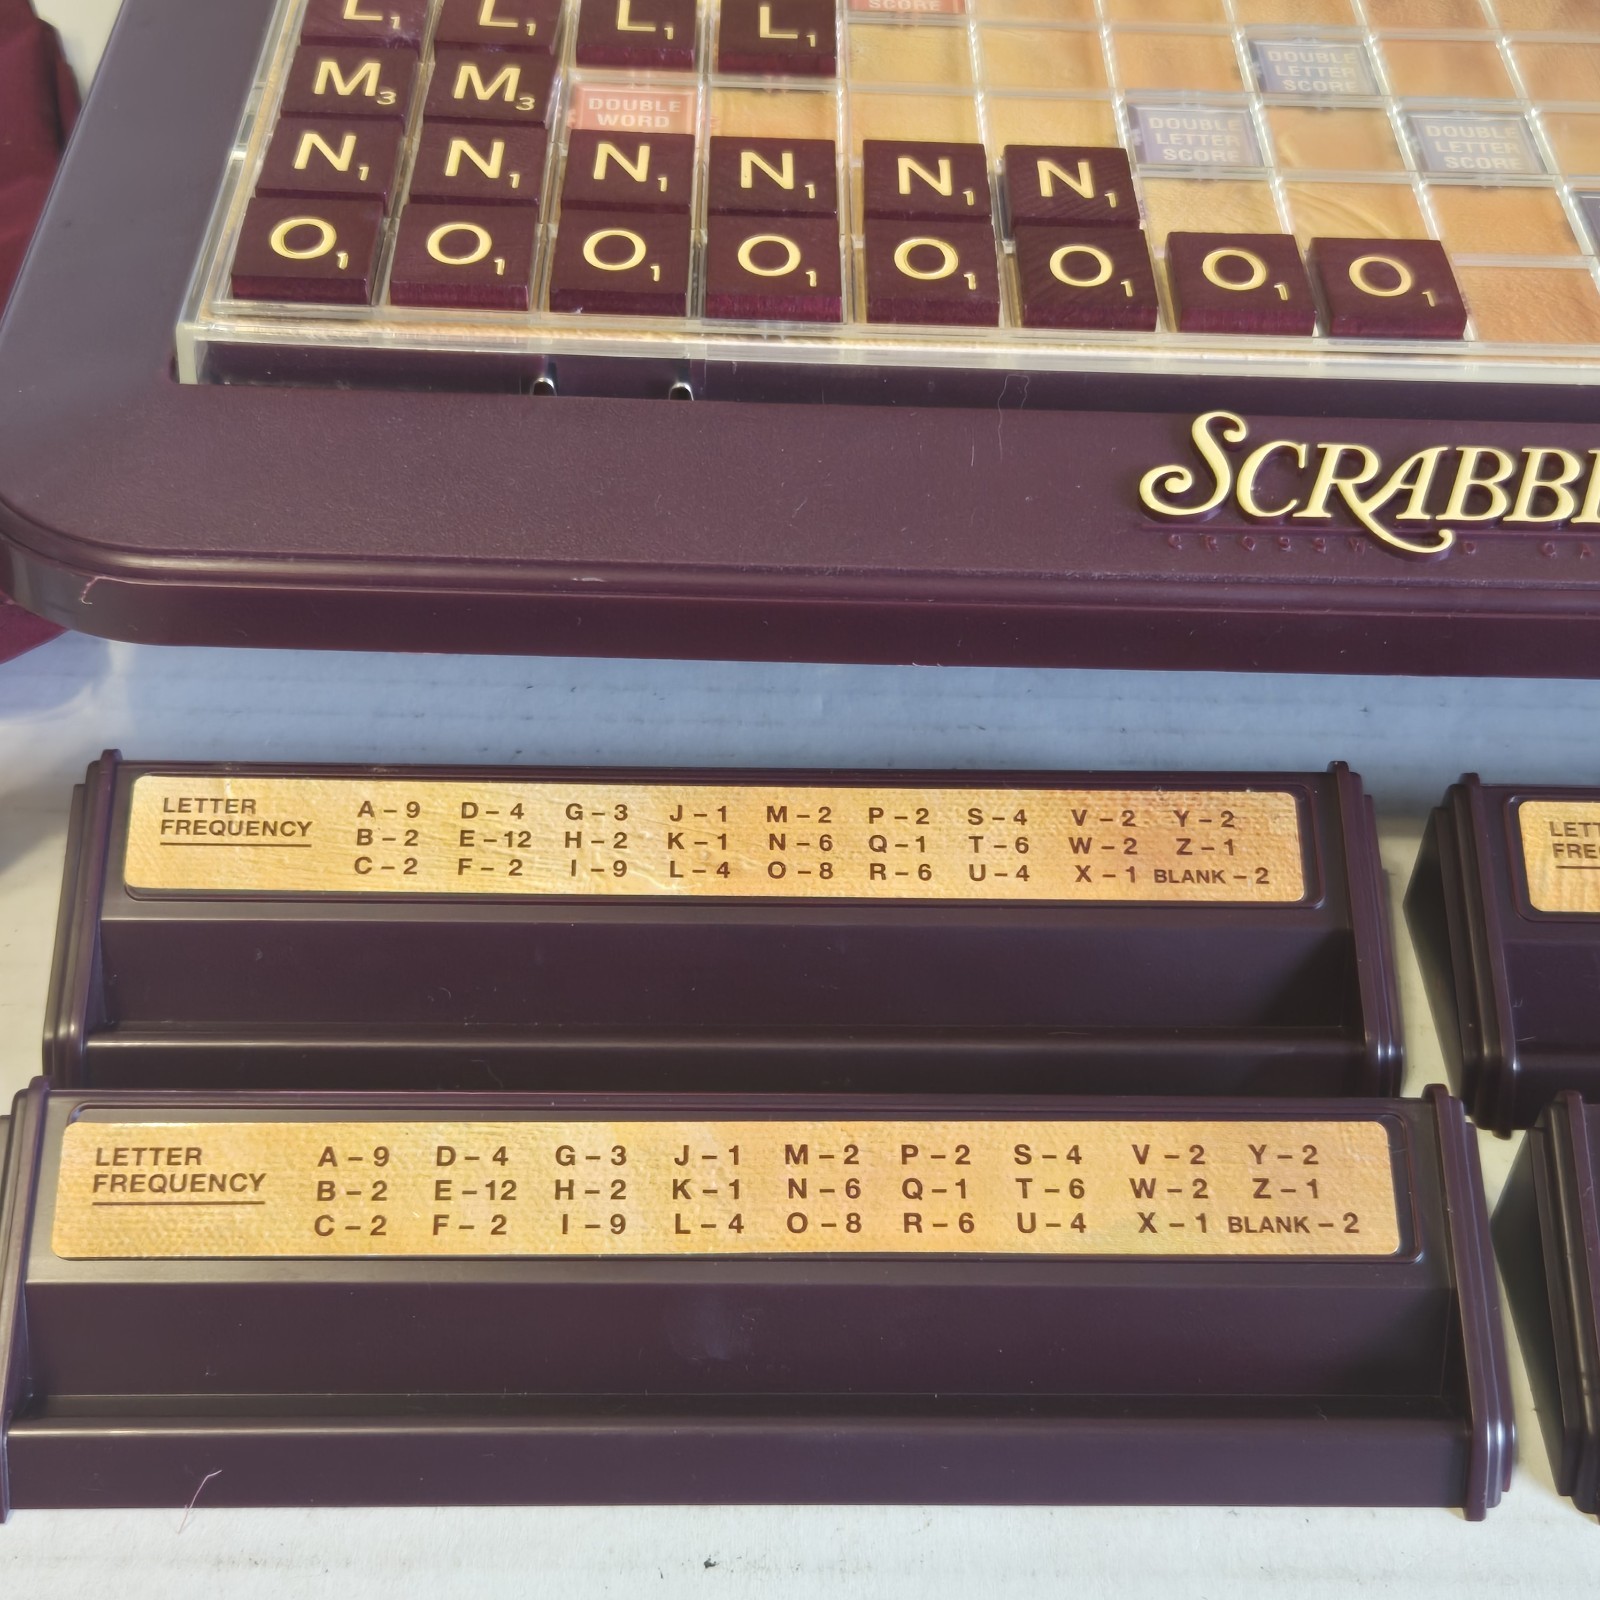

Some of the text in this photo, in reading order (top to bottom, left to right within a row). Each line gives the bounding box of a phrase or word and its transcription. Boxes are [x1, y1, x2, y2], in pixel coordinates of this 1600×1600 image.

[1267, 50, 1357, 64] DOUBLE
[1275, 66, 1355, 78] LETTER
[1282, 80, 1358, 93] SCORE
[588, 98, 681, 113] DOUBLE
[598, 114, 670, 128] WORD
[1149, 117, 1242, 132] DOUBLE
[1425, 125, 1518, 139] DOUBLE
[1156, 133, 1240, 147] LETTER
[1434, 141, 1521, 154] LETTER
[1164, 149, 1241, 162] SCORE
[1444, 157, 1526, 170] SCORE
[162, 797, 257, 815] LETTER
[160, 818, 313, 838] FREQUENCY
[1552, 843, 1600, 858] FRE
[95, 1146, 203, 1167] LETTER
[92, 1172, 267, 1194] FREQUENCY
